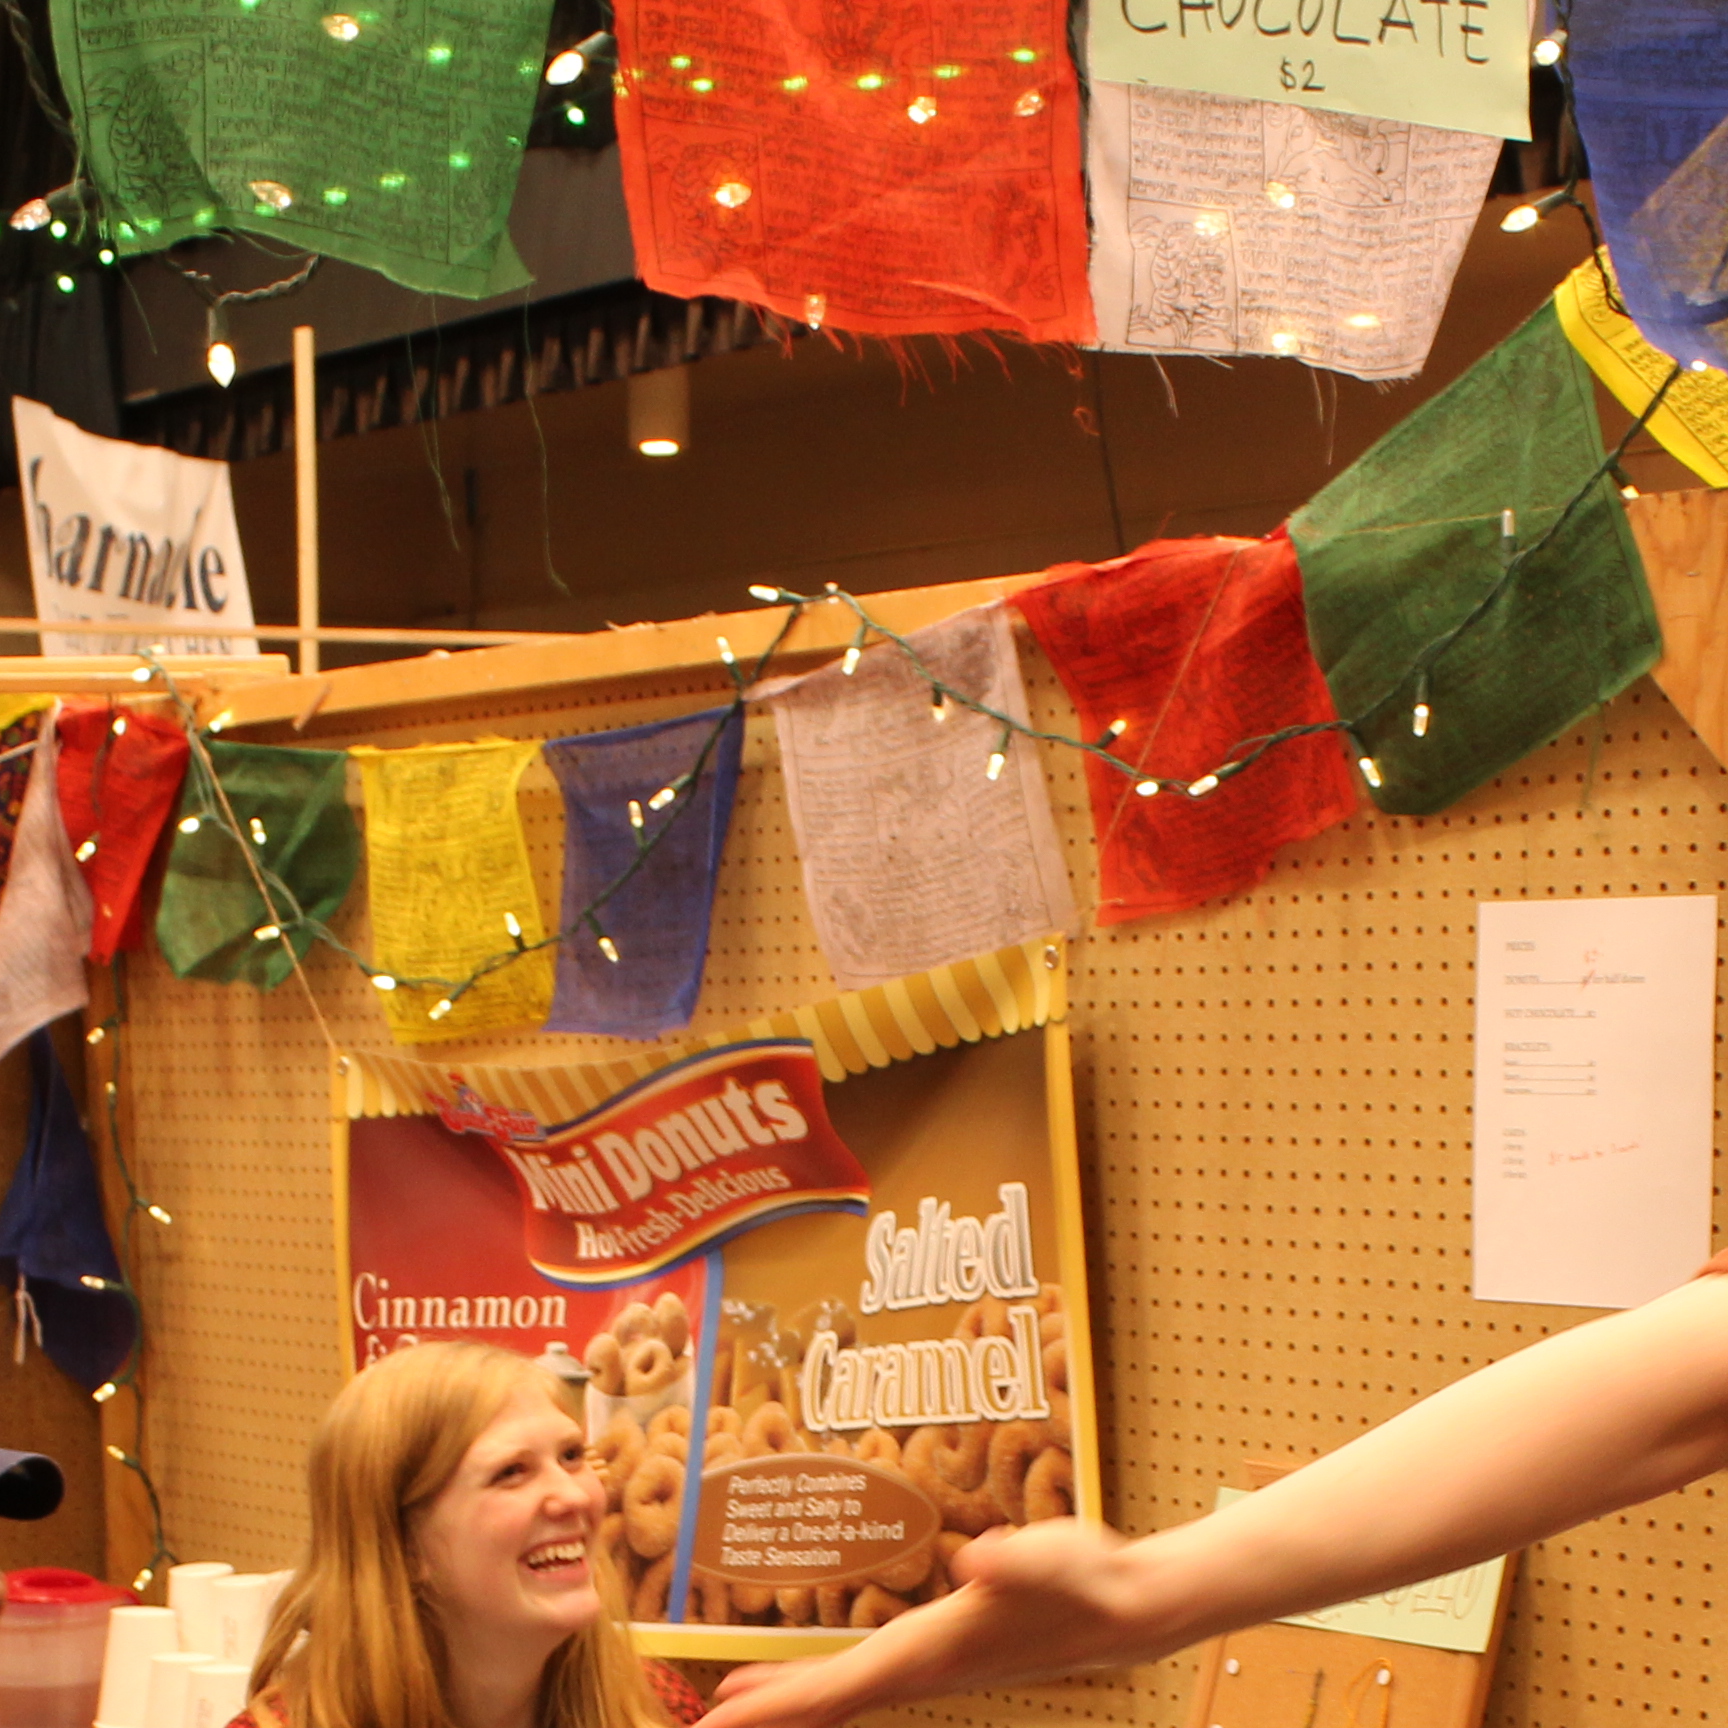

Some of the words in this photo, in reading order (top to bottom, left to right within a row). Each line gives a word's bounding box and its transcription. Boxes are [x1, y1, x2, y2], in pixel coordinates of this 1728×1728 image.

[1278, 55, 1326, 92] $2
[505, 1144, 621, 1215] Mini
[591, 1076, 810, 1202] Donuts
[862, 1182, 1041, 1316] Salted
[353, 1272, 569, 1332] Cinnamon
[799, 1305, 1052, 1434] Caramel
[727, 1474, 793, 1498] Perfectly
[794, 1472, 868, 1493] Combines
[725, 1499, 773, 1520] Sweet
[773, 1499, 804, 1518] and
[803, 1496, 843, 1521] Salty
[843, 1499, 863, 1517] to
[722, 1522, 777, 1543] Deliver
[777, 1526, 791, 1543] a
[791, 1519, 906, 1543] One-of-a-kind
[720, 1546, 763, 1566] Taste
[763, 1545, 843, 1567] Sensation
